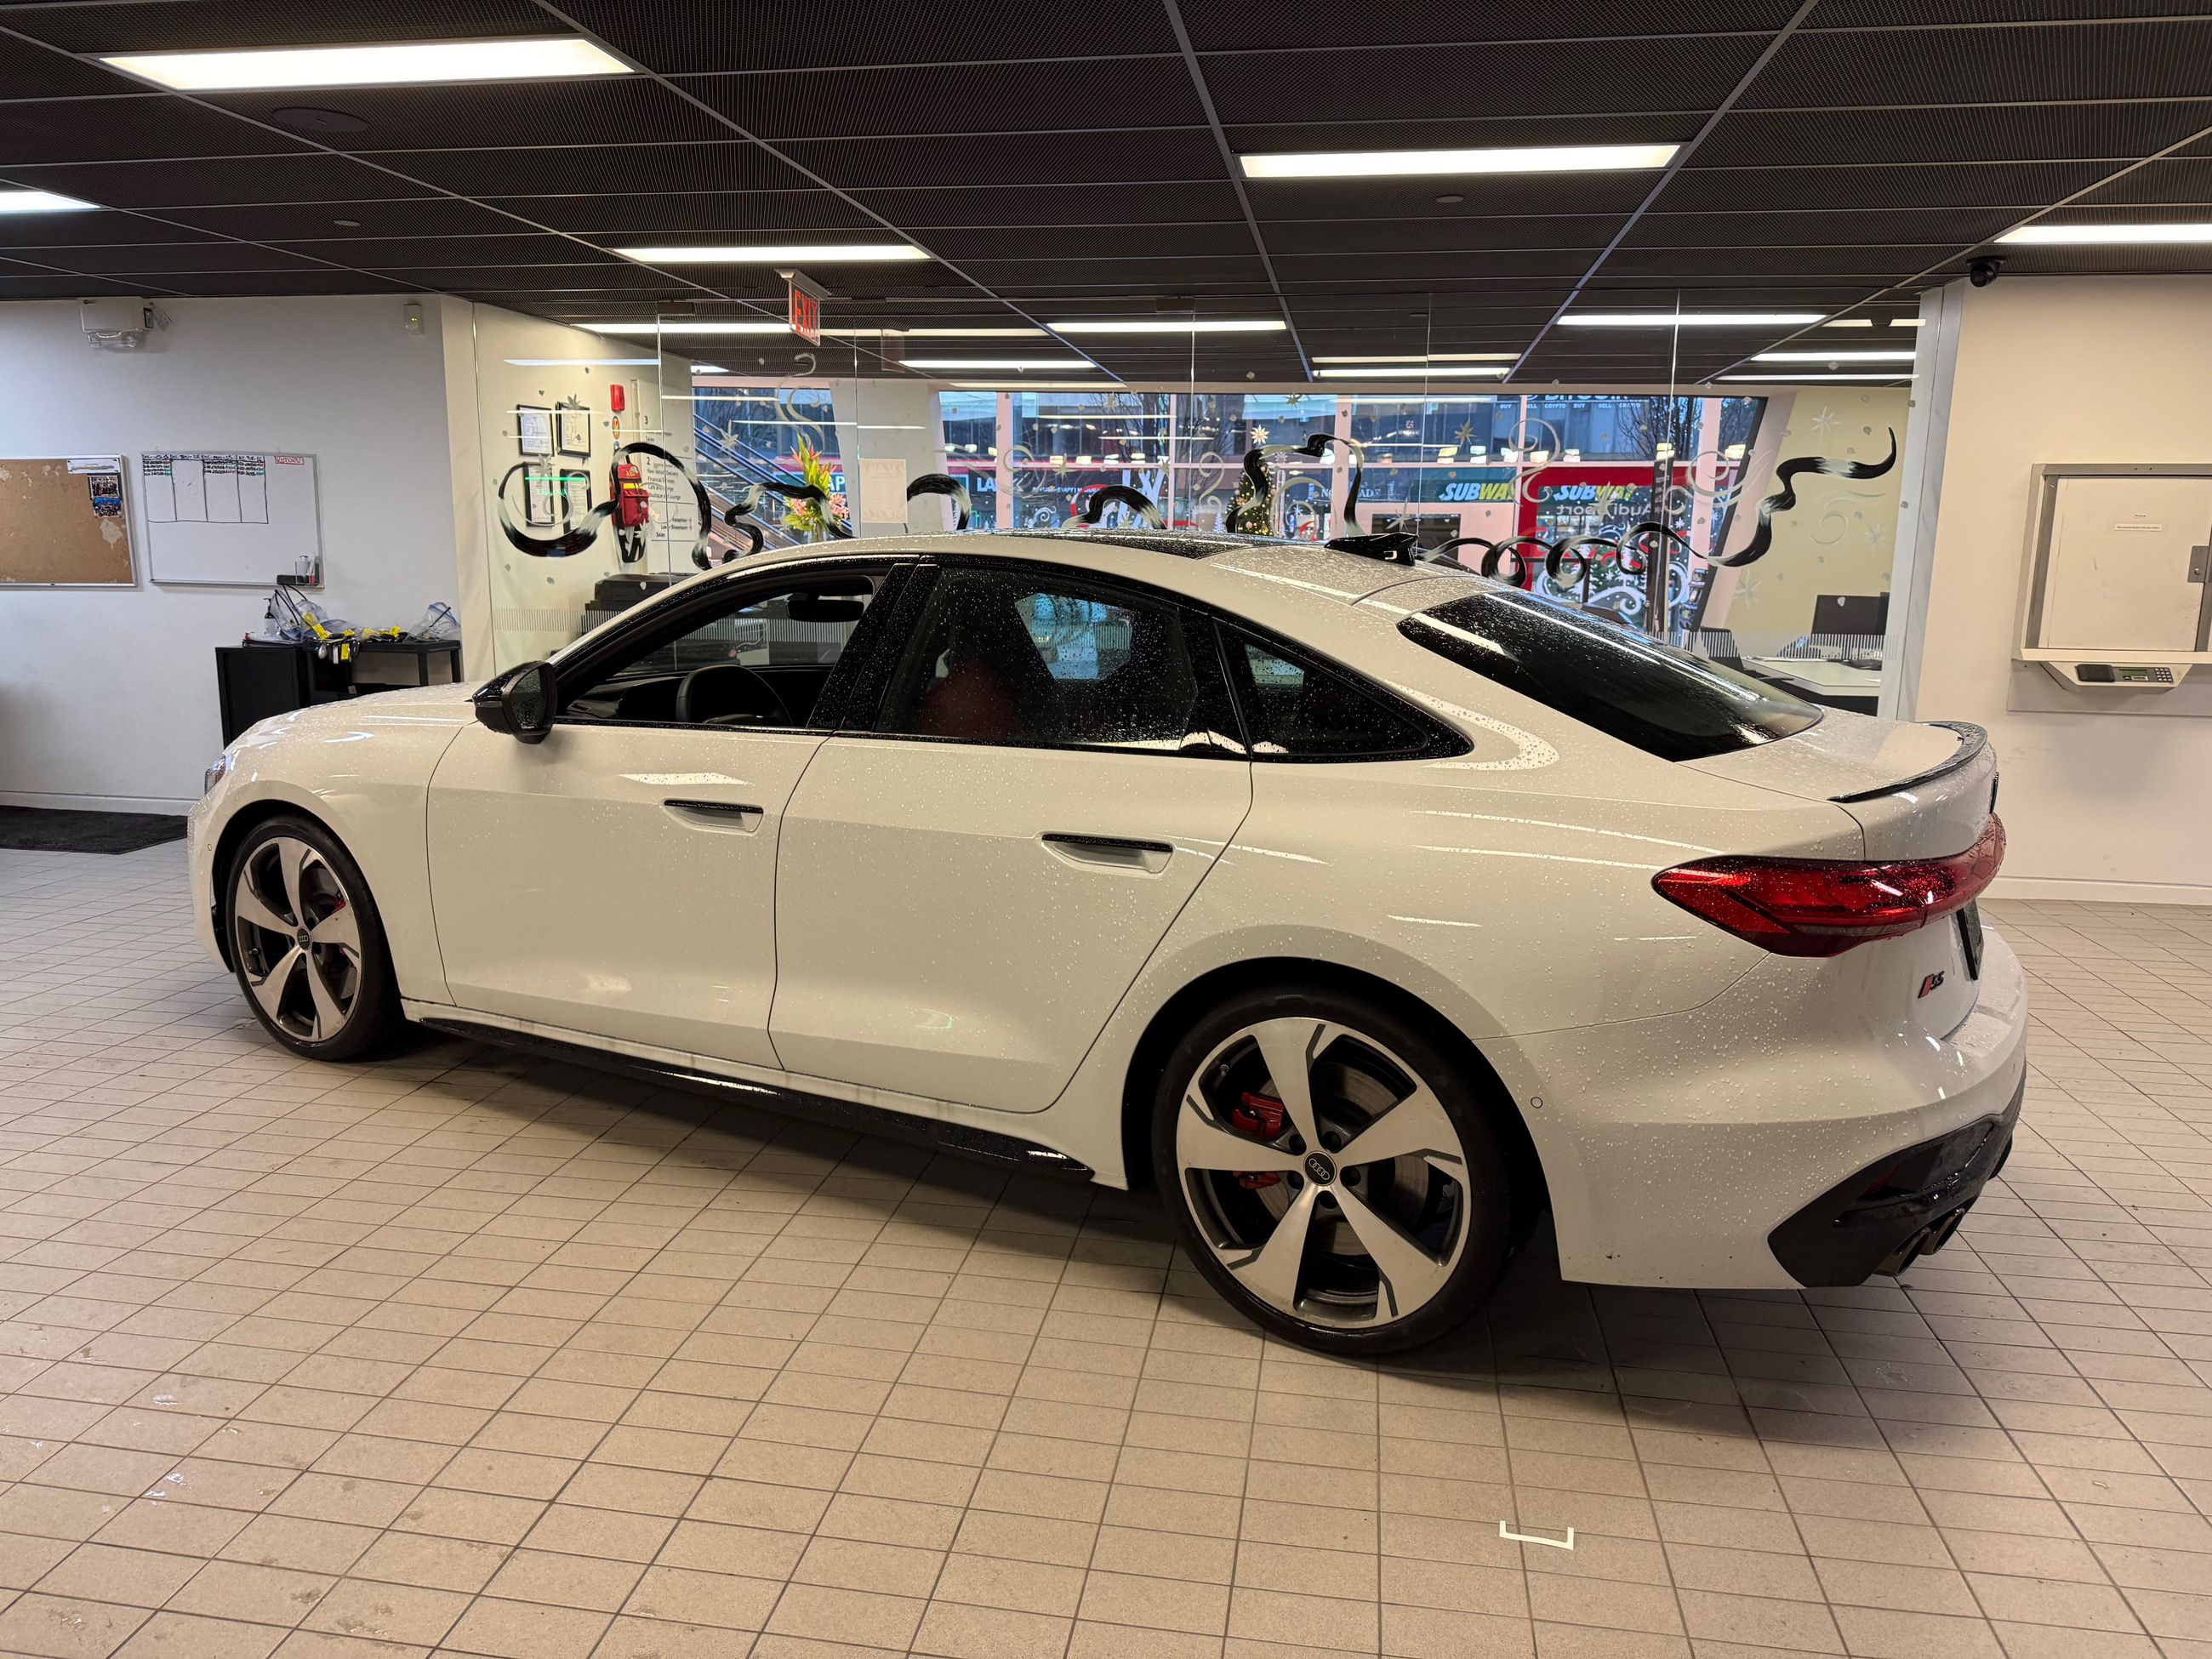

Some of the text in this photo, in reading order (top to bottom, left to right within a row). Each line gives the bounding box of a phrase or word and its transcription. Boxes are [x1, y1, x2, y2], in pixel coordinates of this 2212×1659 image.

[795, 289, 817, 341] EXIT
[644, 415, 648, 425] 3
[647, 456, 651, 465] 2
